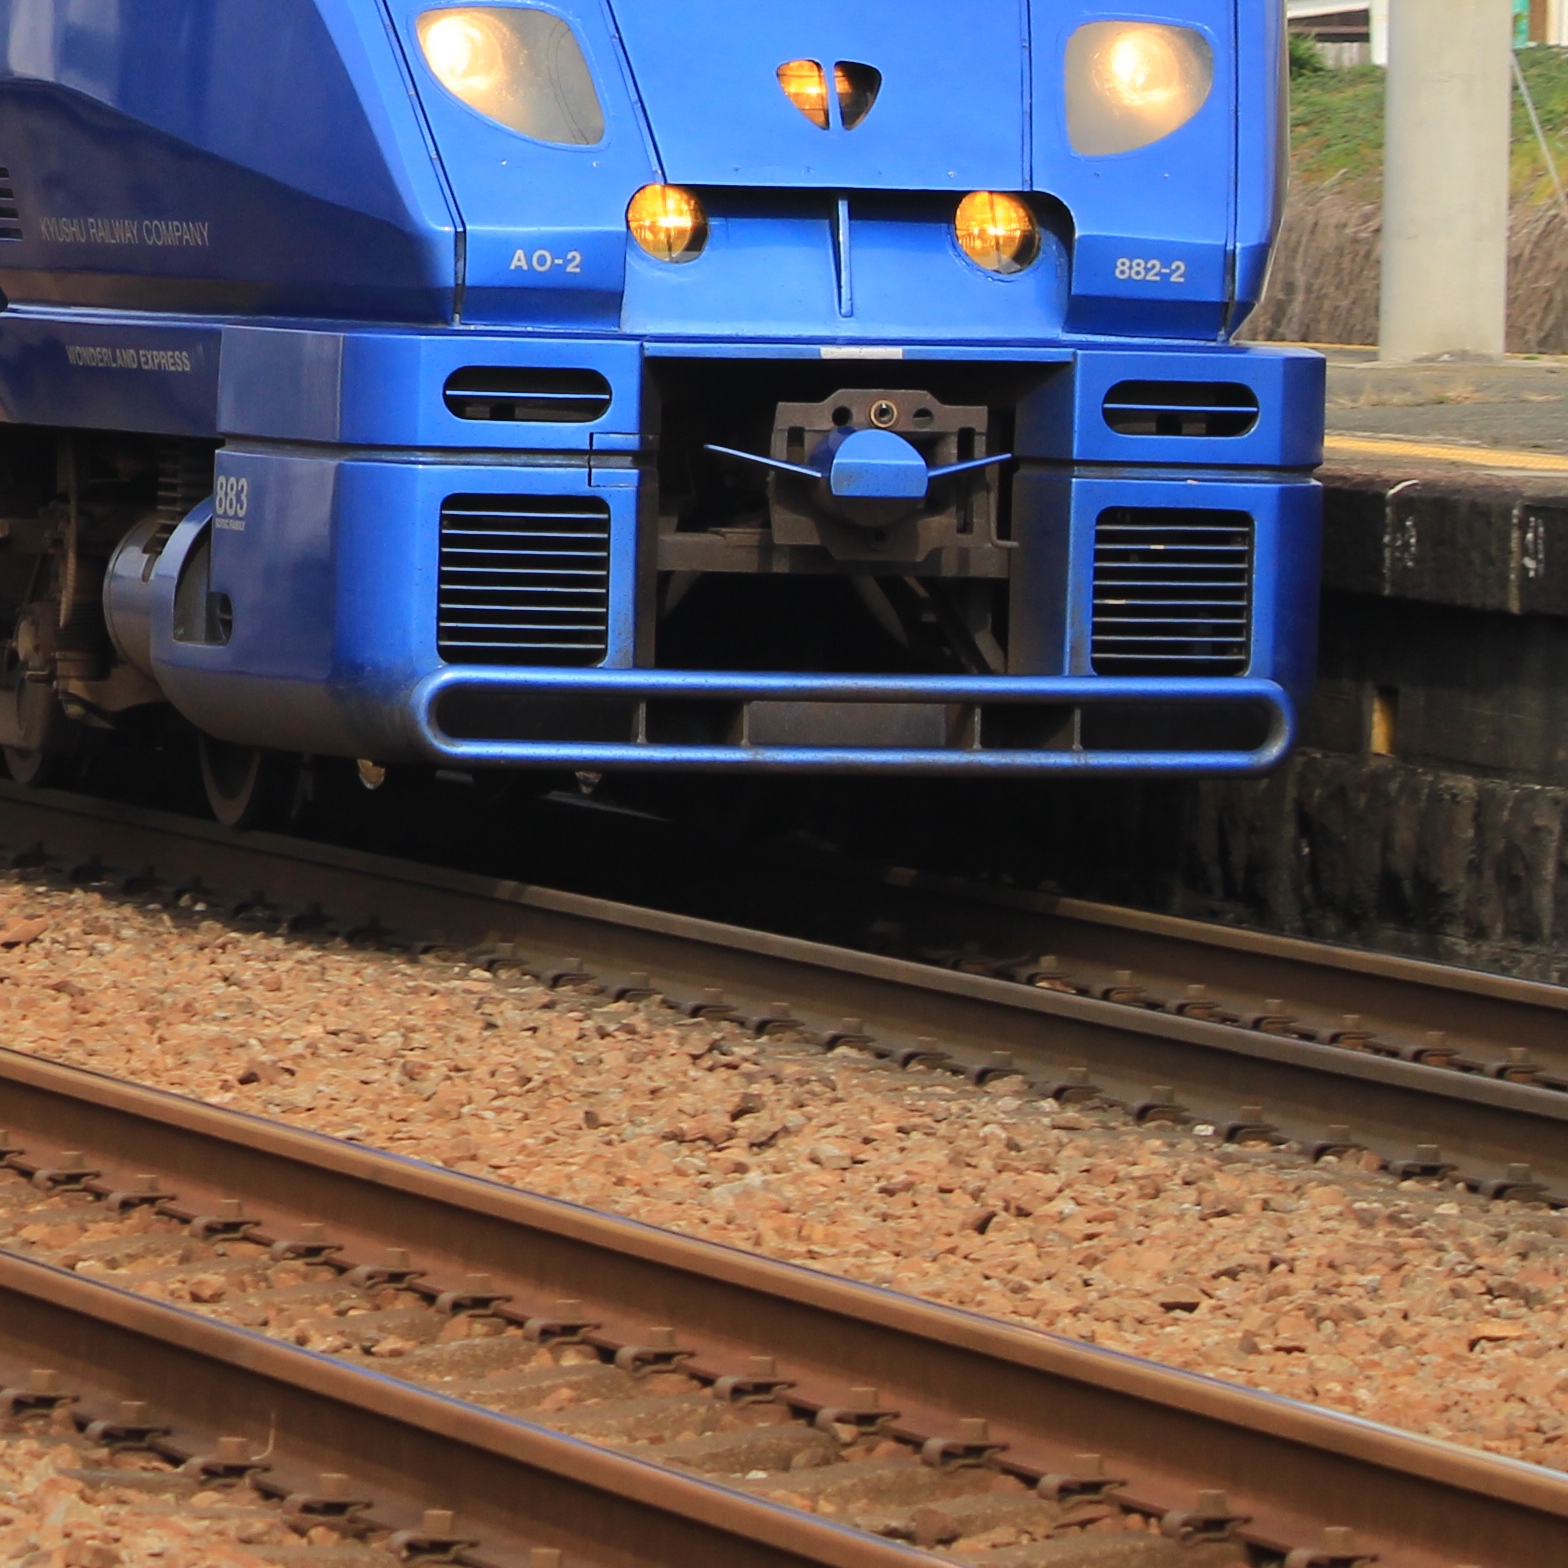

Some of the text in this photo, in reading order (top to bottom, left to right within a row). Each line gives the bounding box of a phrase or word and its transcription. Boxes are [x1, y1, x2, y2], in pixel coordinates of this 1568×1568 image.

[41, 217, 209, 247] KYUSHU RAILWAY COMPANY
[509, 249, 582, 272] AO-2
[1114, 257, 1186, 282] 882-2
[65, 345, 191, 371] WONDERLAND EXPRESS
[216, 475, 247, 517] 883
